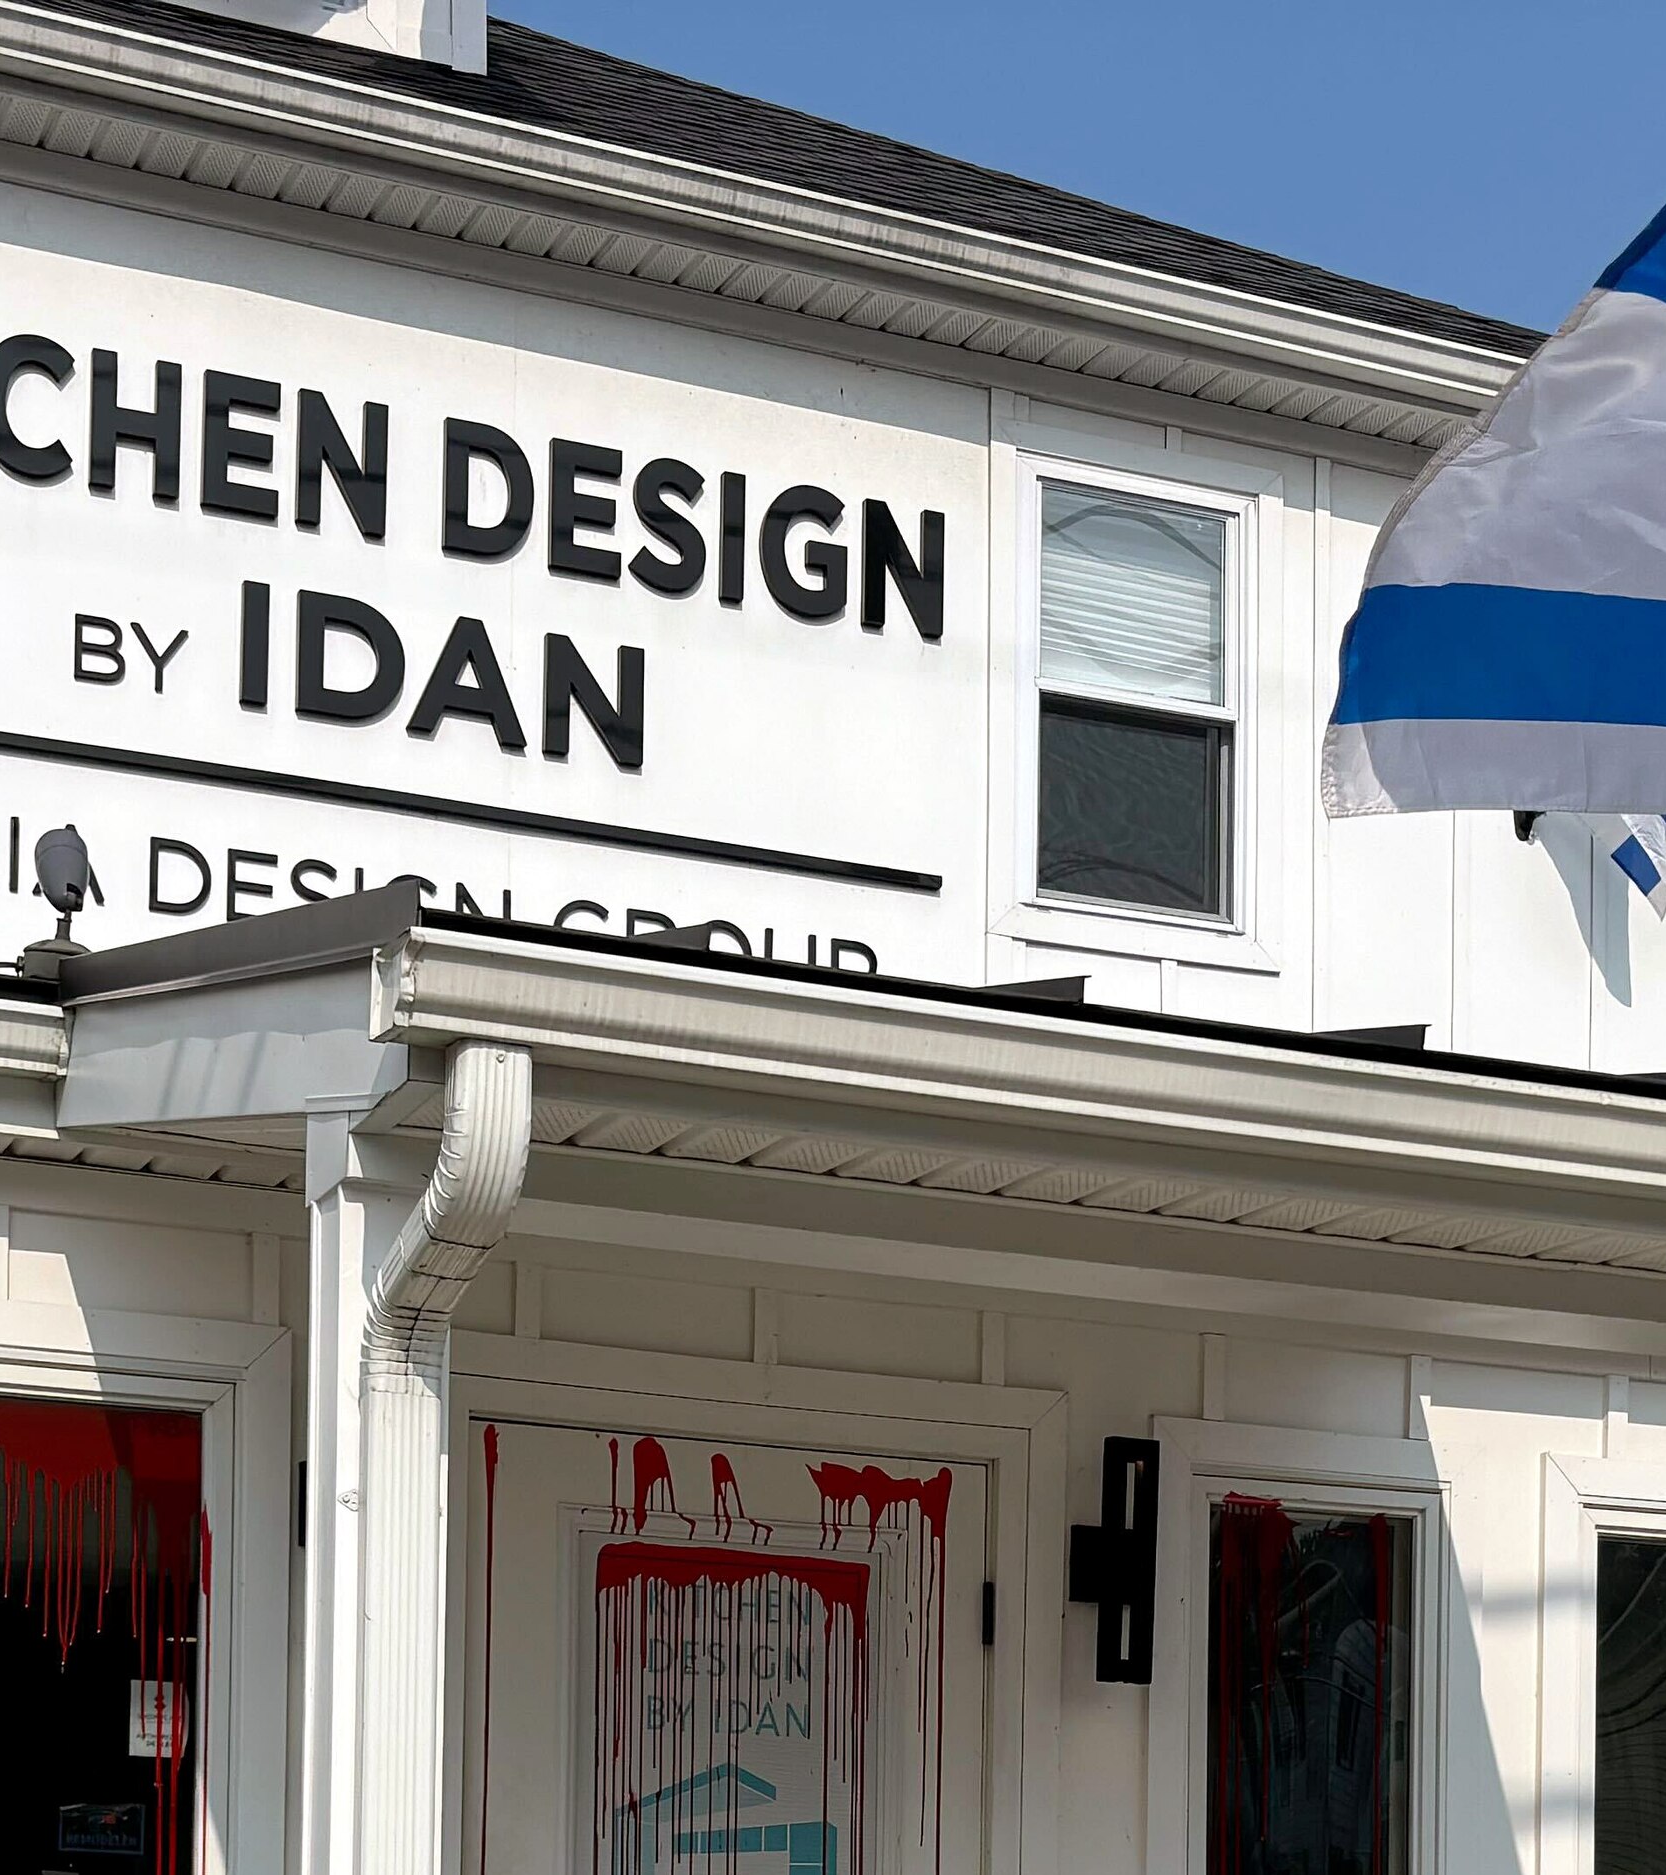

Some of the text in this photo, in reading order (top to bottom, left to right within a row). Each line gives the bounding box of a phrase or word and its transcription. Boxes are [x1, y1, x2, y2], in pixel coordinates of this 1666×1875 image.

[442, 416, 945, 642] DESIGN
[74, 579, 646, 772] BY IDAN
[149, 836, 512, 922] DES
[648, 1581, 810, 1626] KTCHEN
[648, 1638, 810, 1682] DESGN
[647, 1695, 810, 1740] BY IDAN
